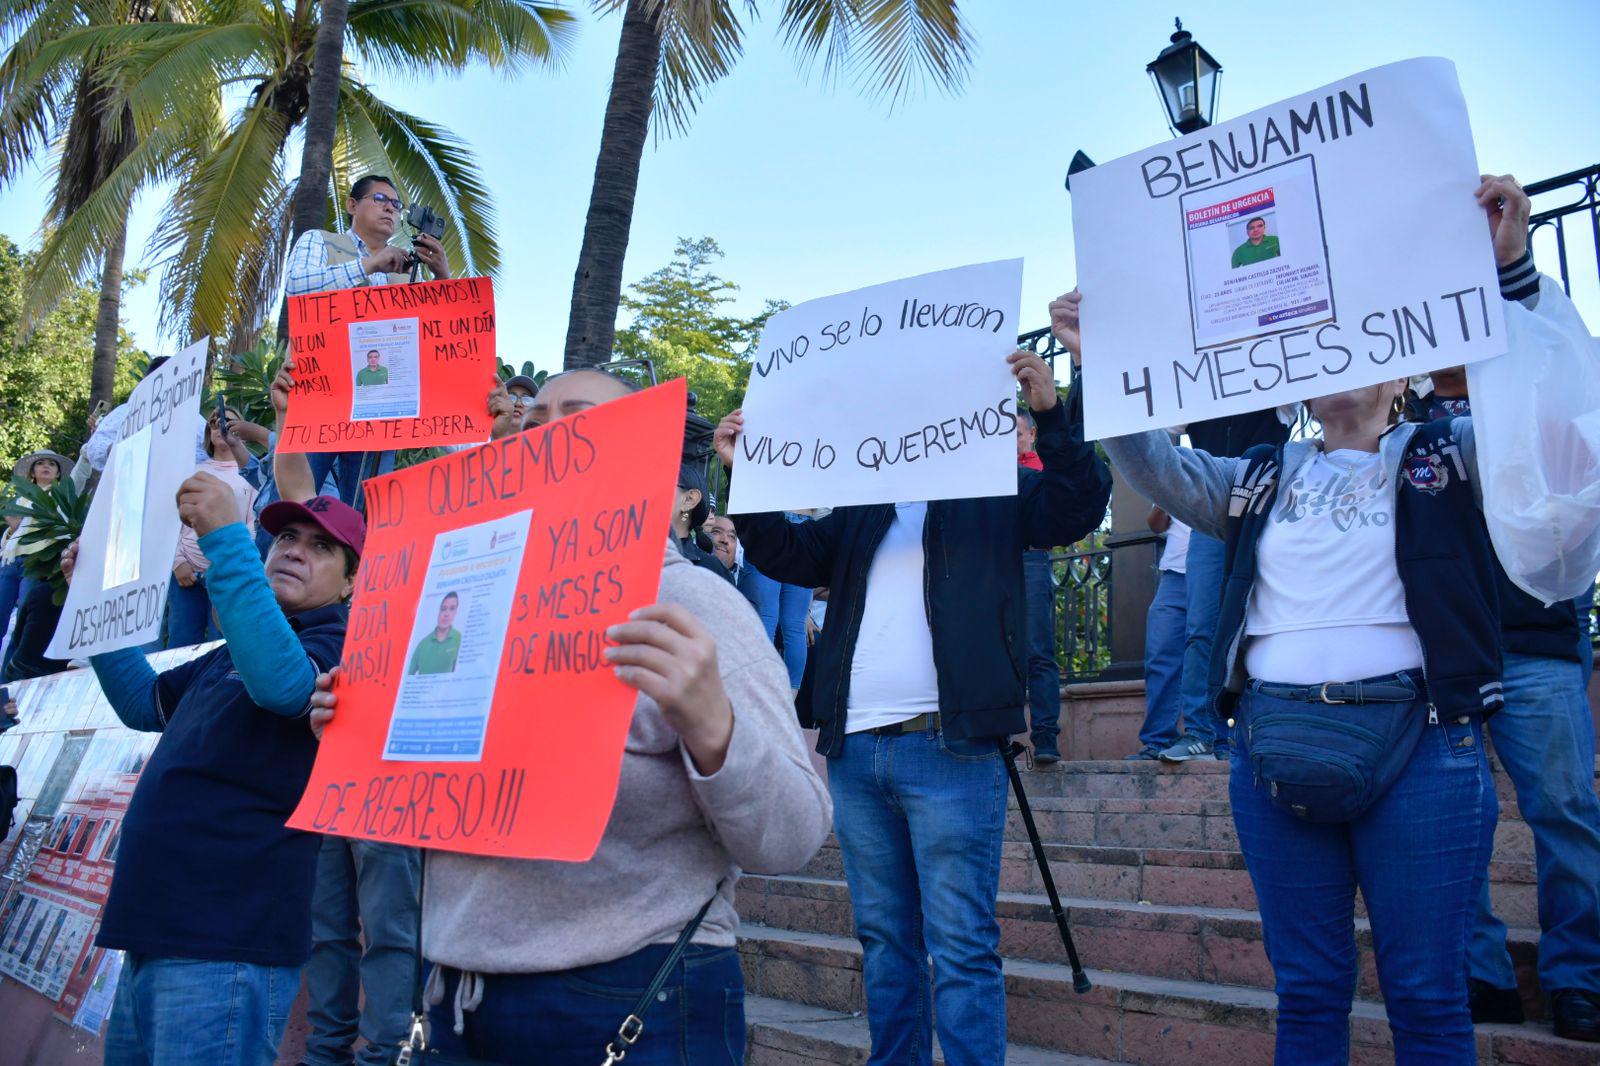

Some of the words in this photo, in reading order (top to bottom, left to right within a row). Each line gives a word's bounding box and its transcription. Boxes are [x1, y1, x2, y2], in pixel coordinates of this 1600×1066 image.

[1140, 83, 1374, 199] BENJAMIN
[1188, 206, 1220, 222] BOLETÍN
[1221, 203, 1232, 213] DE
[1232, 192, 1270, 210] URGENCIA
[423, 319, 442, 340] NI
[450, 317, 471, 336] UN
[1279, 310, 1298, 319] azteca
[291, 336, 303, 354] NI
[307, 333, 326, 350] UN
[435, 338, 481, 362] MAS!!
[756, 335, 810, 377] VIVO
[900, 299, 1005, 333] llevaron
[1123, 366, 1154, 417] 4
[1173, 323, 1353, 409] MESES
[1361, 300, 1437, 365] SIN
[1441, 286, 1491, 342] TI
[294, 375, 333, 396] MAS!!
[297, 358, 321, 375] DIA
[286, 424, 311, 446] TU
[318, 418, 374, 444] ESPOSA
[380, 419, 402, 439] TE
[411, 415, 485, 439] ESPERA...
[743, 434, 802, 467] VIVO
[857, 398, 1018, 471] QUEREMOS
[428, 414, 596, 516] QUEREMOS
[548, 517, 579, 573] YA
[588, 500, 648, 558] SON
[355, 554, 385, 600] NI
[384, 541, 415, 591] UN
[516, 593, 529, 621] 3
[535, 564, 623, 620] MESES
[354, 600, 388, 641] DIA
[336, 639, 393, 688] MAS!!
[508, 633, 540, 675] DE
[313, 782, 356, 832] DE
